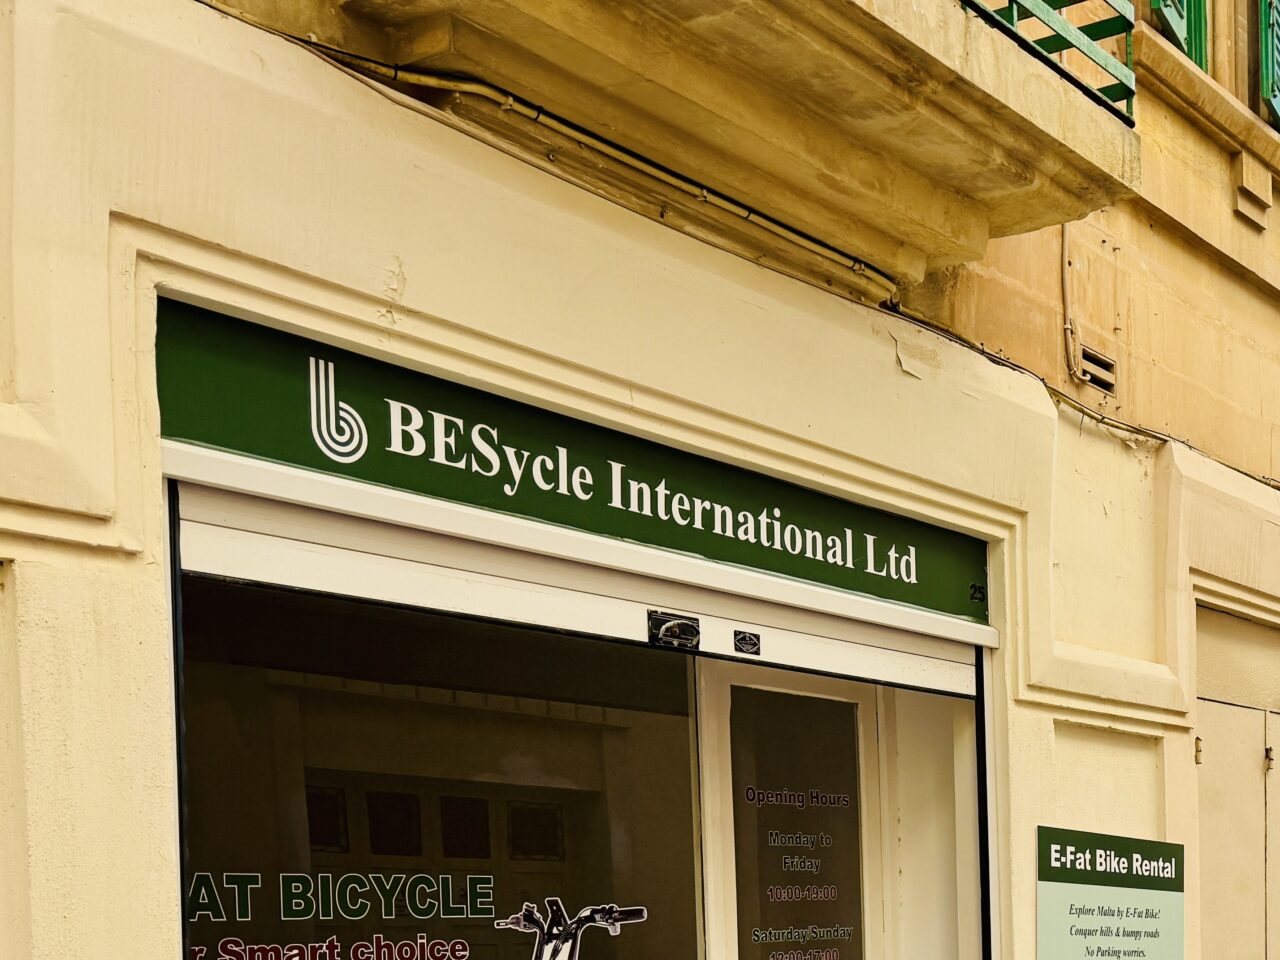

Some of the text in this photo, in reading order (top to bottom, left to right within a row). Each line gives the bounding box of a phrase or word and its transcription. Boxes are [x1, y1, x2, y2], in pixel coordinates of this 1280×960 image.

[384, 398, 918, 584] BESycle International Ltd
[969, 582, 986, 602] 25
[745, 785, 849, 809] Opening Hours
[768, 830, 832, 850] Monday to
[783, 855, 821, 874] Friday
[1050, 844, 1176, 880] E-Fat Bike Rental
[280, 873, 495, 921] BICYCLE
[767, 885, 838, 901] 10:00-19:00
[1069, 904, 1095, 918] Explore
[1097, 906, 1115, 917] Malta
[1117, 907, 1124, 920] by
[1126, 907, 1144, 918] E-Fat
[1069, 925, 1160, 940] Conquer hills & bumpy roads
[1085, 946, 1095, 957] No
[1096, 946, 1121, 960] Parking
